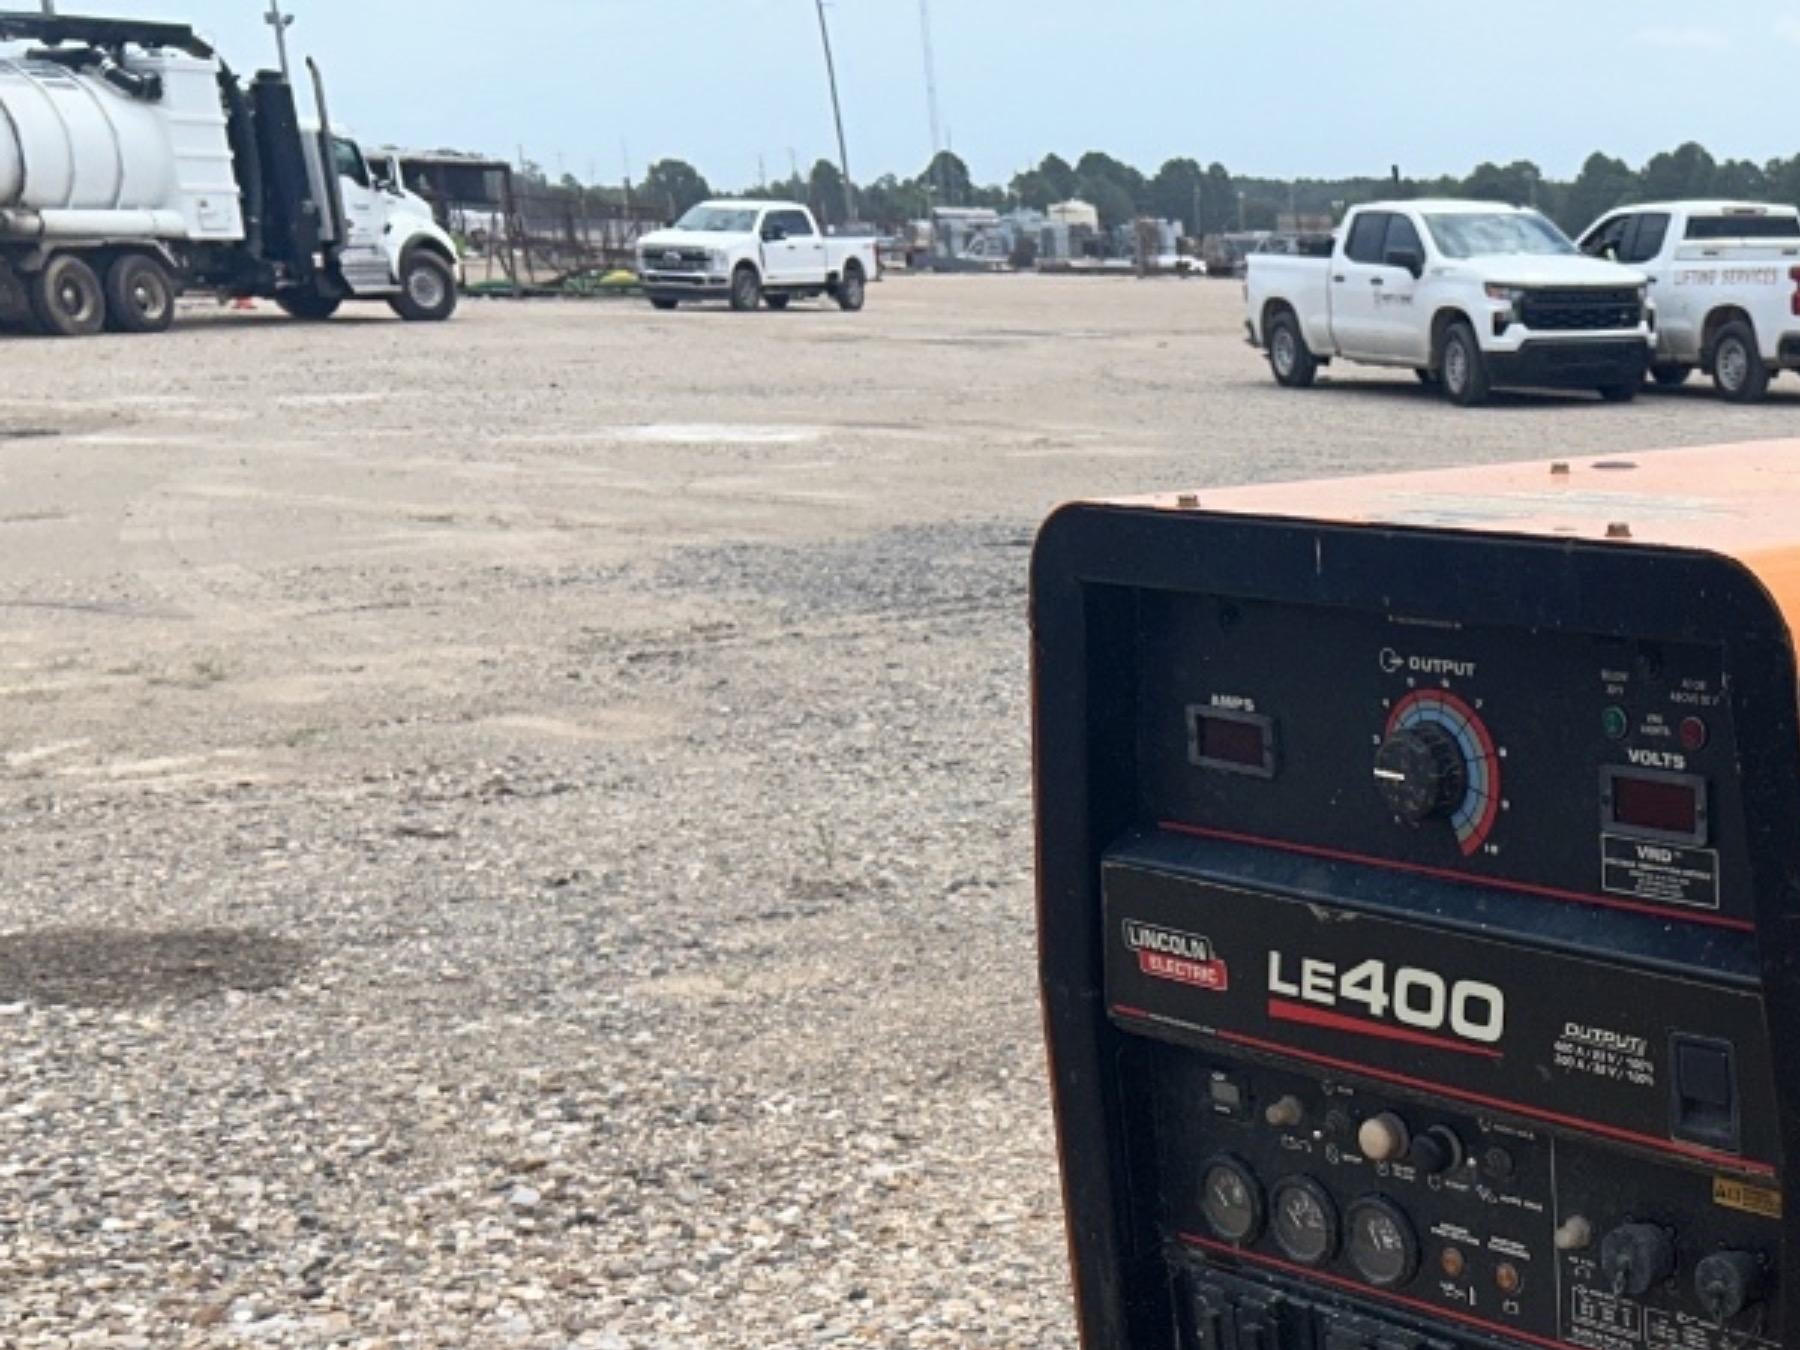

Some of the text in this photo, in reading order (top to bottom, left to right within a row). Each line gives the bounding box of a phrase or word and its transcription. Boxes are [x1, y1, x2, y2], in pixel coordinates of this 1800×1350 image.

[1628, 748, 1686, 769] VOLTS
[1127, 926, 1207, 960] LINCOLN
[1268, 950, 1504, 1043] LE400
